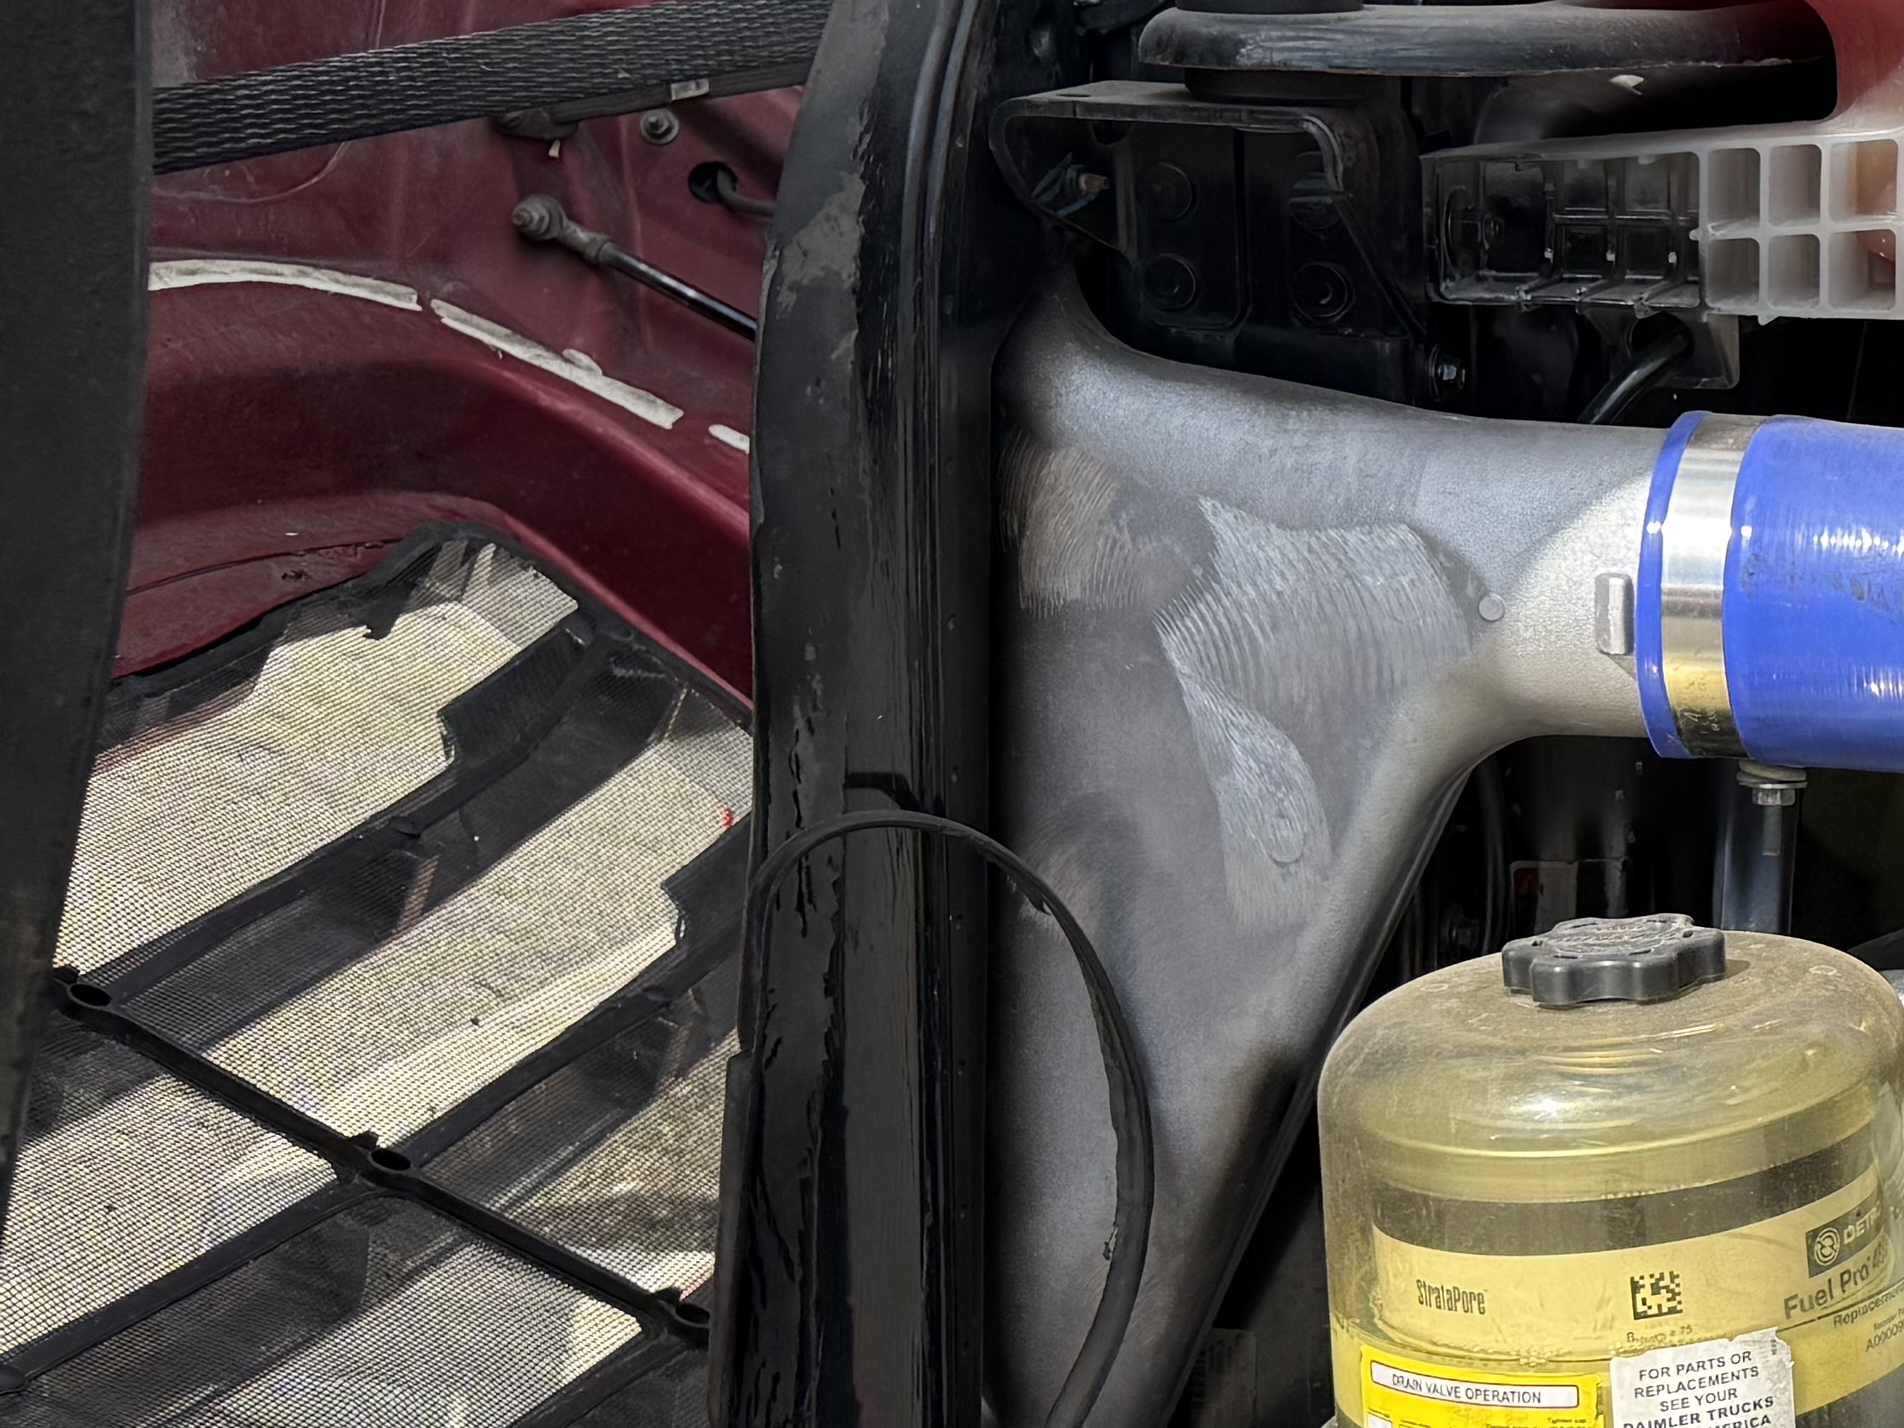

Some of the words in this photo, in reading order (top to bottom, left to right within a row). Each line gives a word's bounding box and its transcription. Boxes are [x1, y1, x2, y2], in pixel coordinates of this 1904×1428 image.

[1416, 1279, 1486, 1315] StrataPore
[1783, 1278, 1833, 1319] Fuel
[1840, 1264, 1869, 1293] Pro
[1639, 1367, 1671, 1381] FOR
[1676, 1356, 1726, 1375] PARTS
[1731, 1350, 1752, 1364] OR
[1391, 1373, 1423, 1393] DRAIN
[1425, 1381, 1461, 1399] VALVE
[1465, 1386, 1541, 1404] OPERATION
[1634, 1366, 1759, 1399] REPLACEMENTS
[1660, 1397, 1691, 1412] SEE
[1695, 1388, 1738, 1406] YOUR
[1706, 1396, 1774, 1421] TRUCKS
